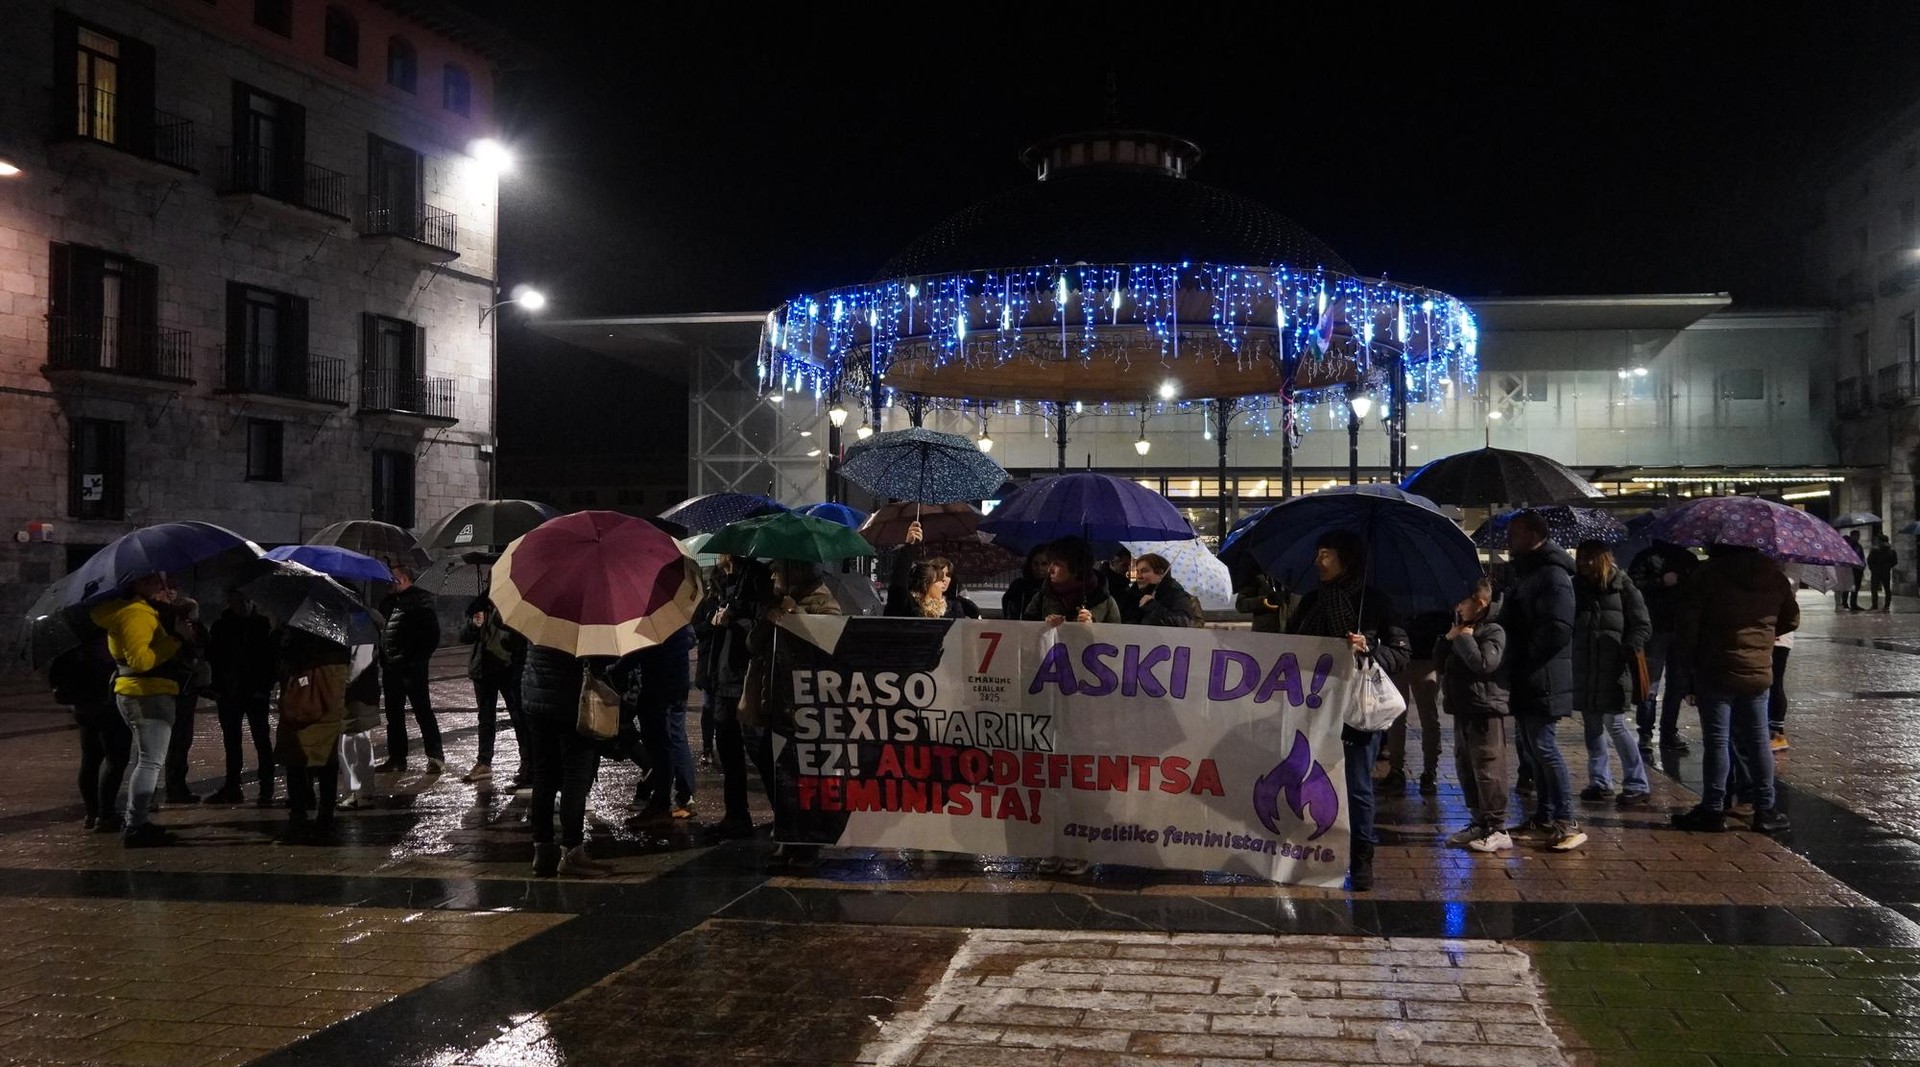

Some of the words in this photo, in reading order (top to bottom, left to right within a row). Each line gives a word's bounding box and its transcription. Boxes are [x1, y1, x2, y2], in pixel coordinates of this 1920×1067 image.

[978, 632, 1003, 674] 7
[792, 670, 937, 708] ERASO
[967, 676, 1012, 684] EMAKUME
[1028, 643, 1191, 699] ASKI
[1207, 649, 1334, 709] DA!
[979, 693, 1001, 703] 2025
[794, 706, 1054, 752] SEXISTARIK
[796, 743, 860, 777] EZ!
[876, 743, 1225, 797] AUTODEFENTSA
[797, 777, 1042, 824] FEMINISTA!
[1063, 822, 1160, 844] azpeitiko
[1162, 825, 1277, 855] feministan
[1280, 841, 1336, 863] sarie
